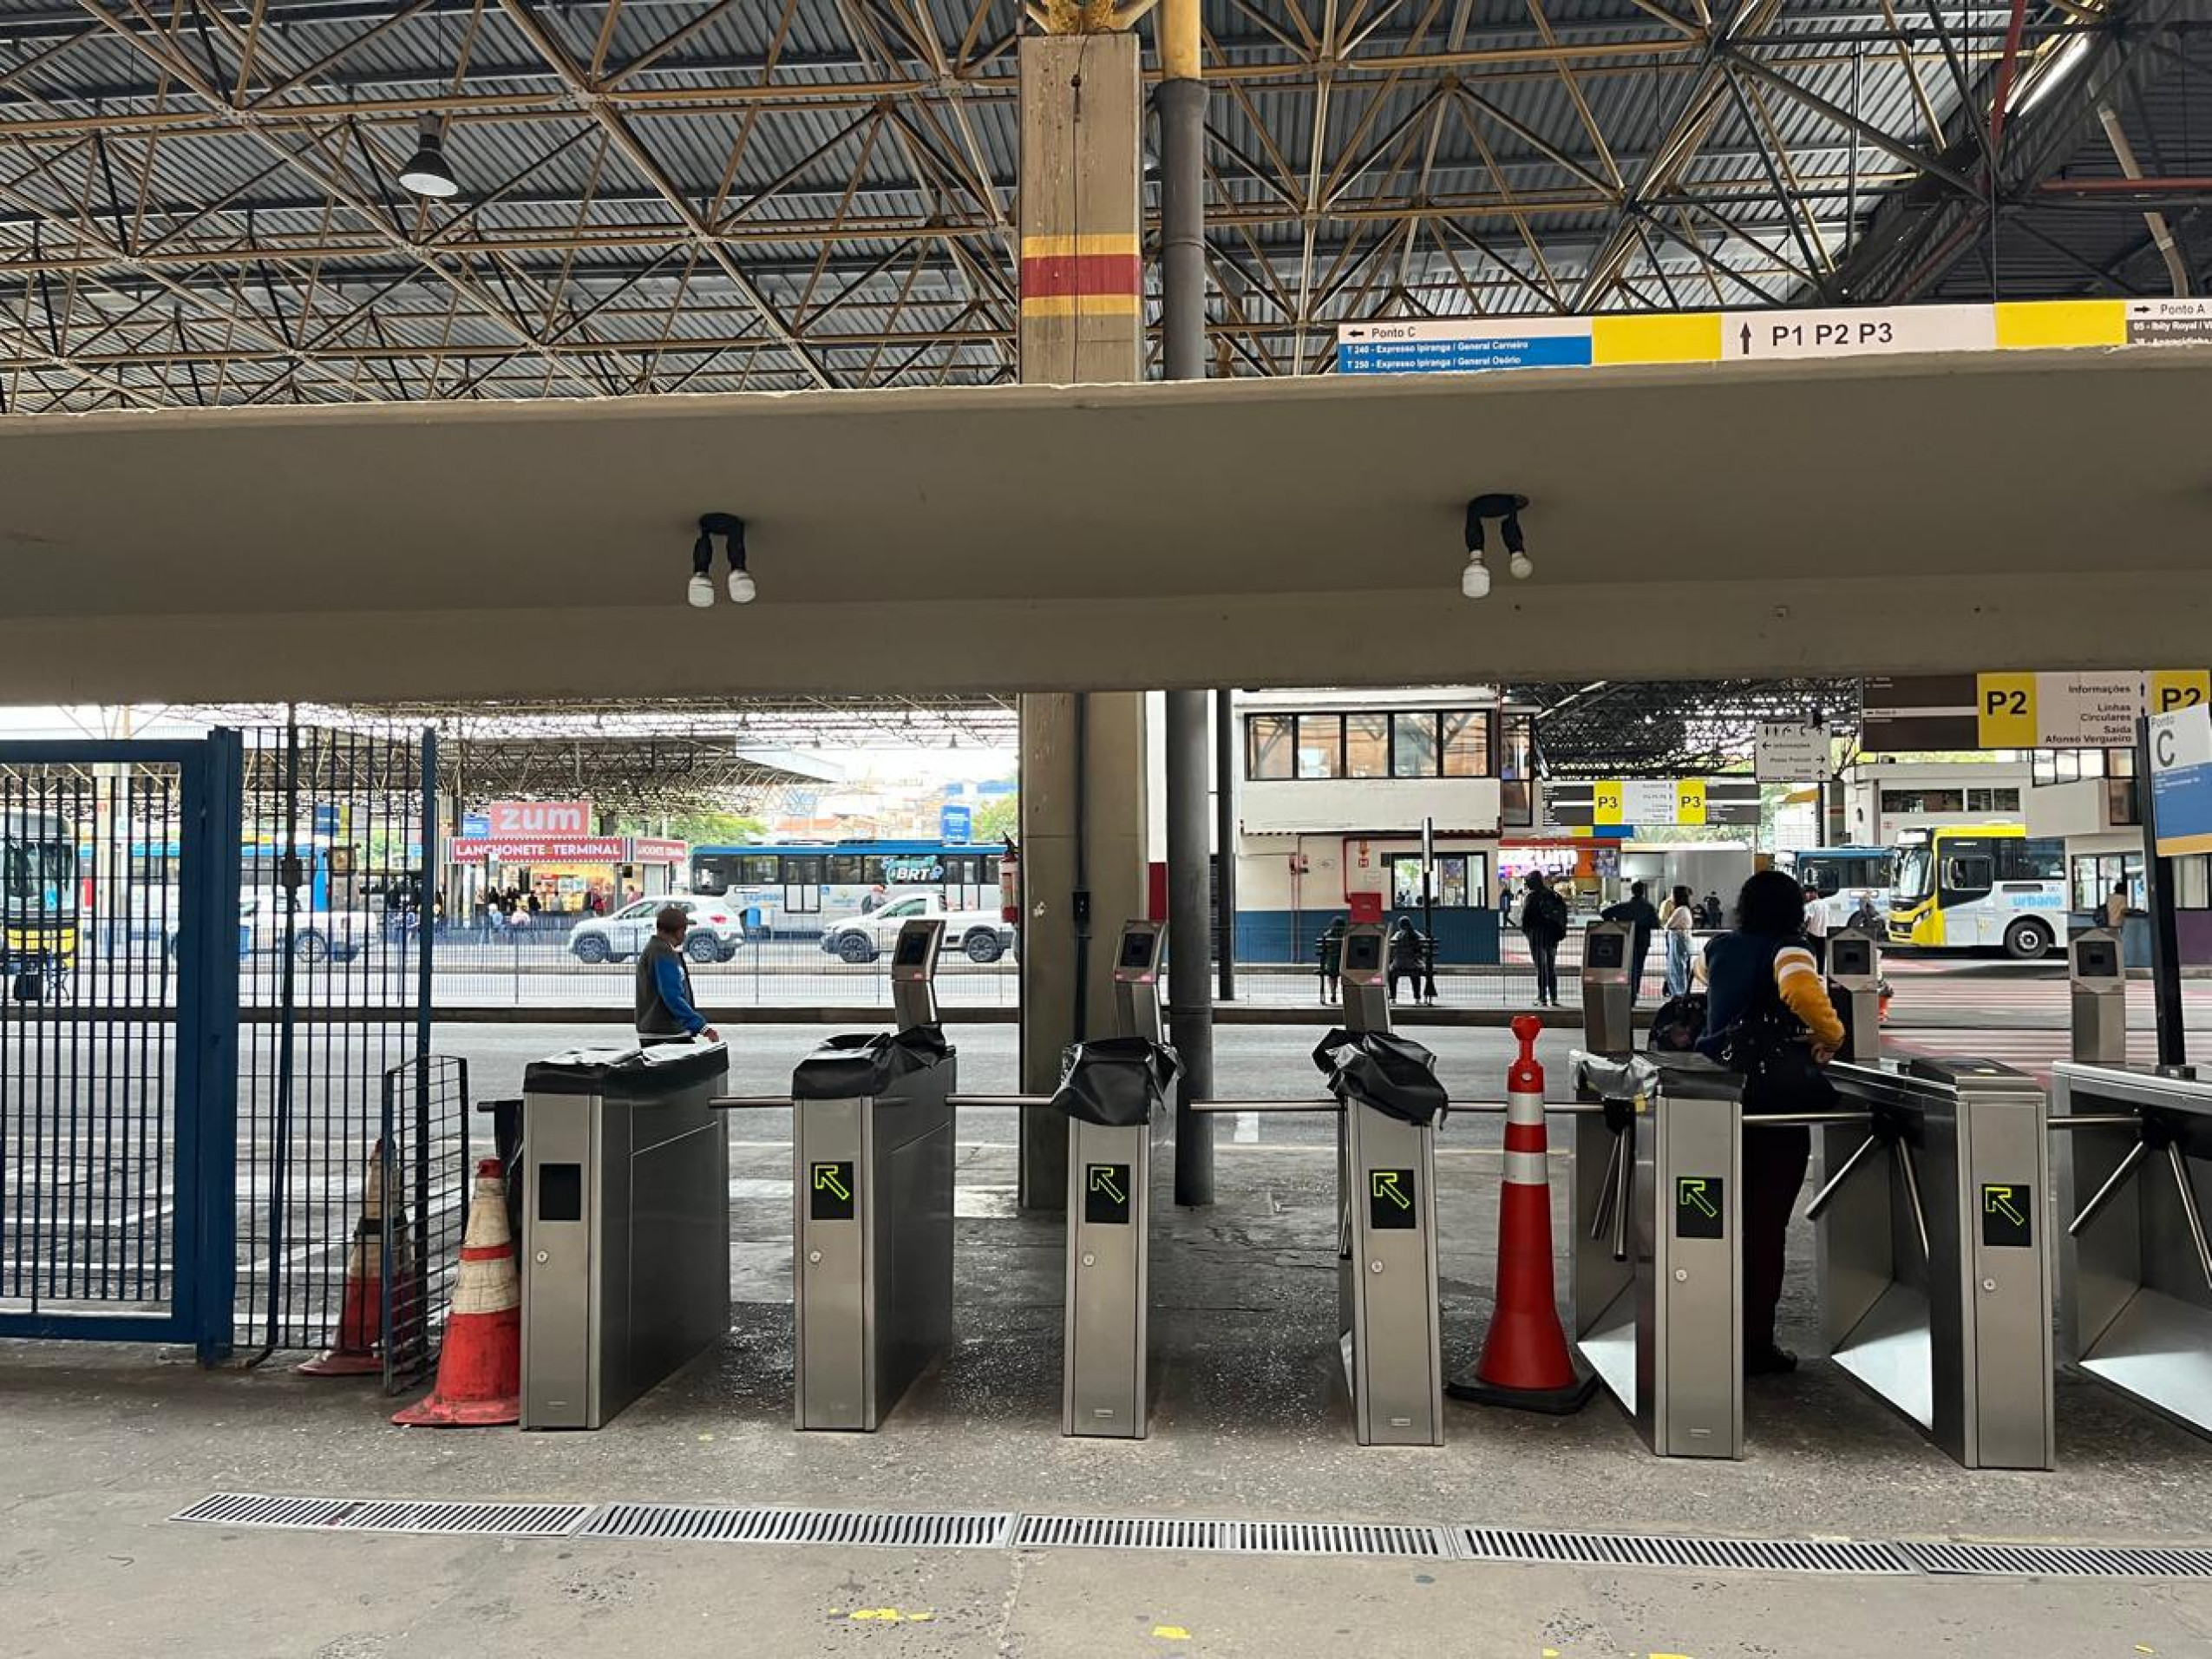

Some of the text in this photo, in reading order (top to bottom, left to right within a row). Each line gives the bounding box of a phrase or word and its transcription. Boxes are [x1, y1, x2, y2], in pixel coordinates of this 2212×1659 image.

[2160, 304, 2205, 315] Ponto A
[1371, 326, 1416, 338] Ponto C
[2171, 320, 2197, 332] Royal
[1772, 322, 1893, 346] P1 P2 P3
[1346, 345, 1352, 354] T
[1377, 344, 1416, 354] Expresso
[1417, 344, 1450, 353] Ipiranga
[1457, 342, 1490, 351] General
[1492, 340, 1528, 350] Carneiro
[1346, 361, 1352, 370] T
[1377, 359, 1416, 370] Expresso
[1417, 358, 1450, 368] Ipiranga
[1457, 357, 1490, 365] General
[2068, 685, 2131, 695] Informações
[1986, 691, 2027, 715] P2
[2162, 688, 2201, 712] P2
[2080, 713, 2131, 722] Circulares
[2045, 735, 2131, 745] Afonso Vergueiro
[2156, 729, 2175, 768] C
[1598, 797, 1618, 809] P3
[1681, 797, 1700, 808] P3
[500, 808, 581, 830] zum
[455, 844, 621, 856] LANCHONETE TERMINAL
[897, 868, 930, 880] BRT
[2012, 895, 2061, 907] urbano
